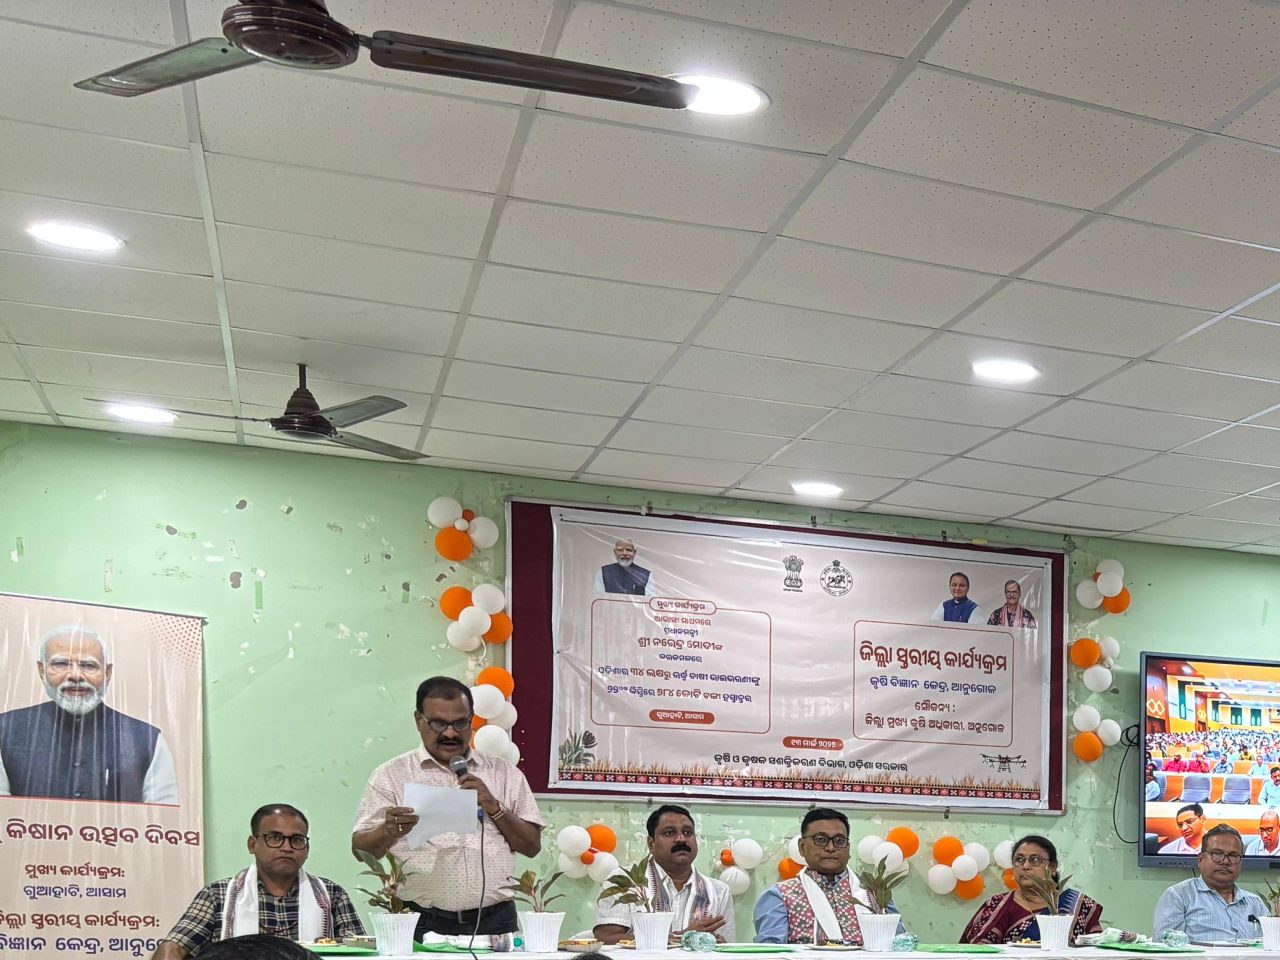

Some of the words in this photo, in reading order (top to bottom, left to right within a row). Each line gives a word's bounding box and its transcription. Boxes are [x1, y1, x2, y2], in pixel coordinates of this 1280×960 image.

[638, 637, 651, 647] ଶ୍ରୀ
[652, 638, 684, 650] ନରେନ୍ଦ୍ର
[859, 640, 893, 668] ଜିଲ୍ଲା
[896, 647, 942, 670] ସ୍ତରୀୟ
[944, 646, 1007, 675] କାର୍ଯ୍ୟକ୍ରମ
[869, 675, 888, 689] କୃଷି
[890, 676, 919, 689] ବିଜ୍ଞାନ
[923, 680, 949, 693] କେନ୍ଦ୍ର,
[951, 682, 997, 696] ଆନୁଗୋଳ
[864, 712, 884, 729] ଜିଲ୍ଲା
[887, 717, 908, 729] ମୁଖ୍ୟ
[910, 716, 926, 731] କୃଷି
[714, 752, 731, 765] କୃଷି
[732, 754, 740, 763] ଓ
[741, 755, 767, 766] କୃଷକ
[848, 759, 874, 771] ଓଡ଼ିଶା
[875, 762, 908, 772] ସରକାର
[6, 818, 74, 841] କିଷାନ
[79, 825, 139, 847] ଉତ୍ସବ
[144, 824, 201, 847] ଦିବସ
[24, 864, 57, 879] ମୁଖ୍ୟ
[23, 884, 83, 900] ଗୁଆହାଟି,
[86, 887, 127, 899] ଆସାମ
[31, 913, 81, 929] ସ୍ତରୀୟ
[55, 937, 104, 955] କେନ୍ଦ୍ର,
